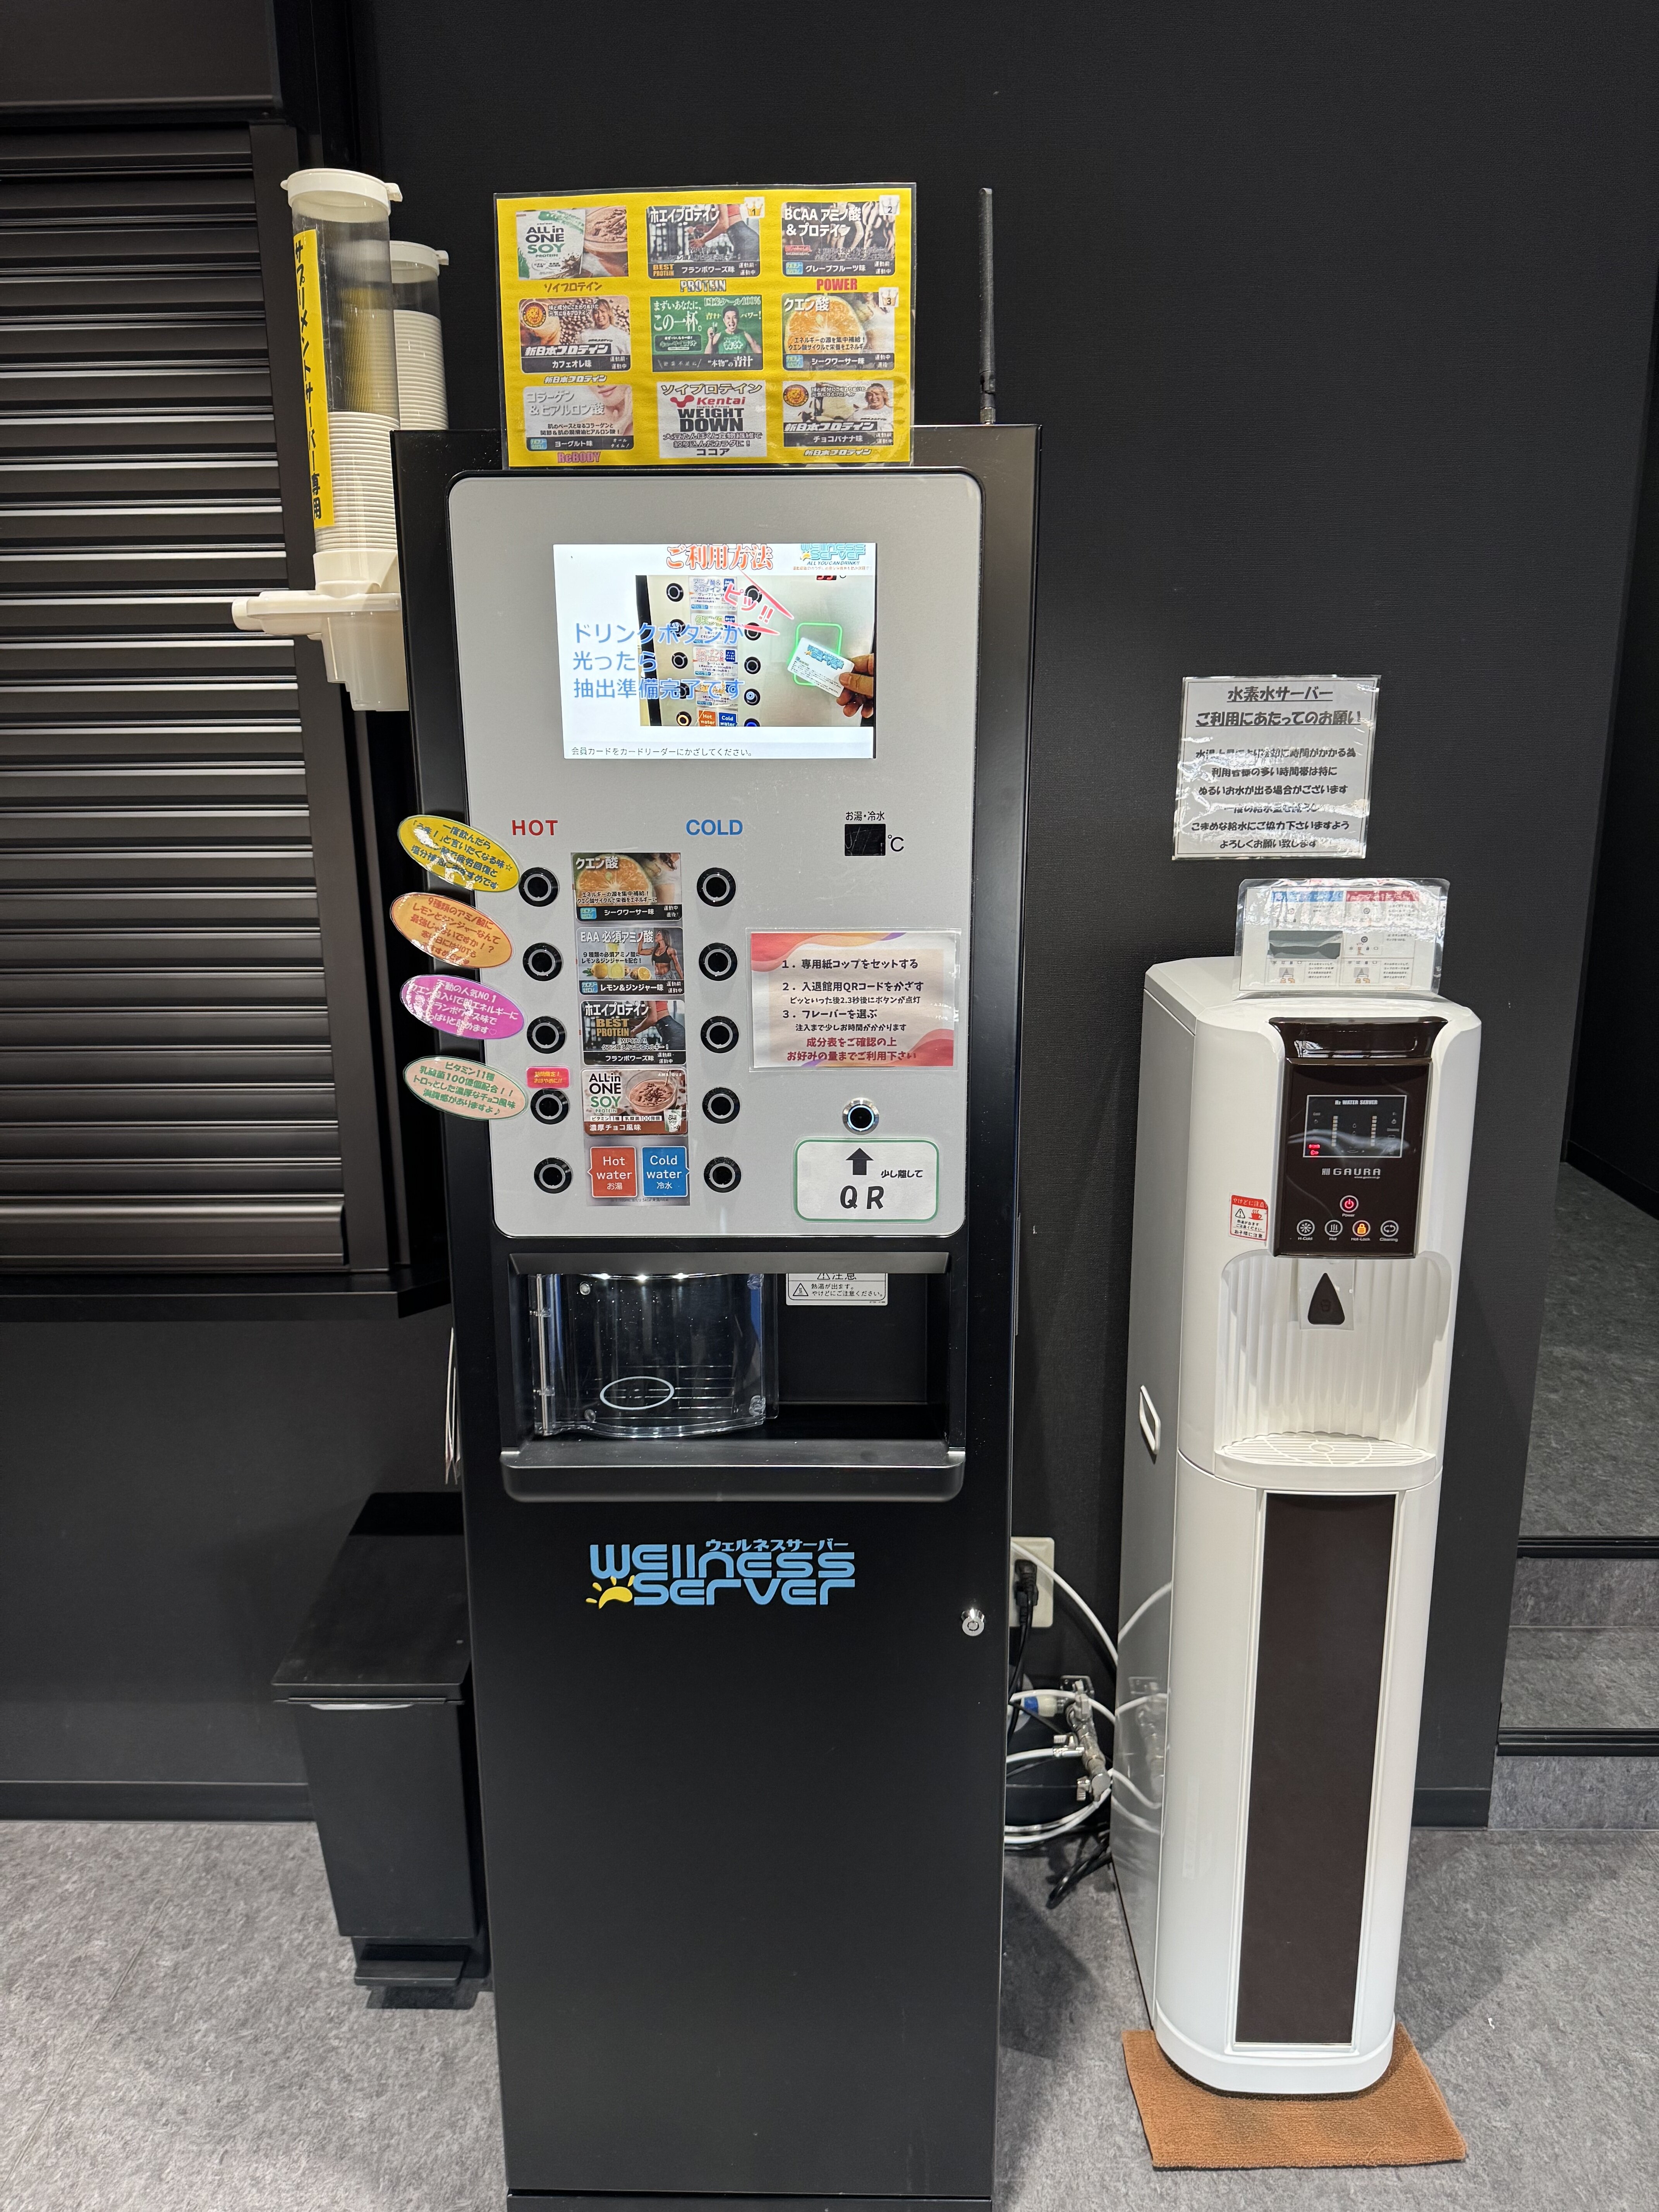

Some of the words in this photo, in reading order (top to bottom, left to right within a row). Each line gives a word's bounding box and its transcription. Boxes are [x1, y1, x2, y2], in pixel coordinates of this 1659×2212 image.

[650, 206, 720, 223] ホエイプロテイン
[785, 209, 818, 220] BCAA
[821, 207, 861, 222] アミノ酸
[526, 234, 564, 243] ONE
[527, 243, 565, 254] SOY
[544, 282, 602, 292] ソイプロテイン
[680, 280, 726, 292] PROTEIN
[817, 278, 857, 291] POWER
[784, 296, 830, 312] クエン酸
[654, 311, 702, 332] この一杯。
[525, 345, 608, 356] 新日本プロテイン
[552, 360, 592, 369] カフェオレ味
[295, 242, 322, 520] サプリメントサーバー専用
[544, 375, 607, 384] 新日本プロテイン
[661, 383, 763, 395] ソイプロテイン
[527, 390, 575, 403] コラーゲン
[697, 397, 746, 405] Kentai
[677, 408, 744, 418] WEIGHT
[680, 418, 743, 432] DOWN
[784, 422, 874, 432] 新日本プロテイン
[557, 452, 601, 463] ReBODY
[666, 544, 773, 570] ご利用方法
[573, 651, 658, 672] 光ったら
[1228, 686, 1333, 701] 水素水サーバー
[571, 747, 752, 757] 会員カードをカードリーダーにかざしてください。
[1199, 785, 1348, 795] ぬるいお水が出る場合がございます
[846, 811, 885, 821] お湯・冷水
[512, 820, 558, 836] HOT
[686, 819, 744, 836] COLD
[1191, 821, 1350, 831] こまめな給水にご協力下さいますよう
[443, 824, 491, 850] 一度飲んだら
[1219, 839, 1316, 849] よろしくお願い致します
[575, 856, 618, 870] クエン酸
[428, 898, 493, 930] 9種類のアミノ酸に
[412, 903, 501, 945] レモンとジンジャーなんて
[580, 931, 599, 942] EAA
[602, 930, 653, 943] 必須アミノ酸
[585, 1002, 649, 1016] ホエイプロテイン
[596, 1018, 629, 1027] BEST
[795, 1023, 907, 1032] 注入まで少しお時間がかかります
[596, 1028, 629, 1037] PROTEIN
[807, 1037, 897, 1047] 成分表をご確認の上
[787, 1051, 917, 1061] お好みの量までご利用下さい
[445, 1062, 495, 1082] ビタミン11種
[589, 1073, 610, 1082] ALL
[589, 1083, 621, 1094] ONE
[591, 1096, 621, 1108] SOY
[603, 1156, 625, 1166] Hot
[650, 1155, 678, 1166] Cold
[596, 1170, 632, 1180] water
[647, 1170, 682, 1179] water
[881, 1170, 923, 1178] 少し離して
[607, 1182, 623, 1190] お湯
[706, 1539, 848, 1551] ウェルネスサーバー
